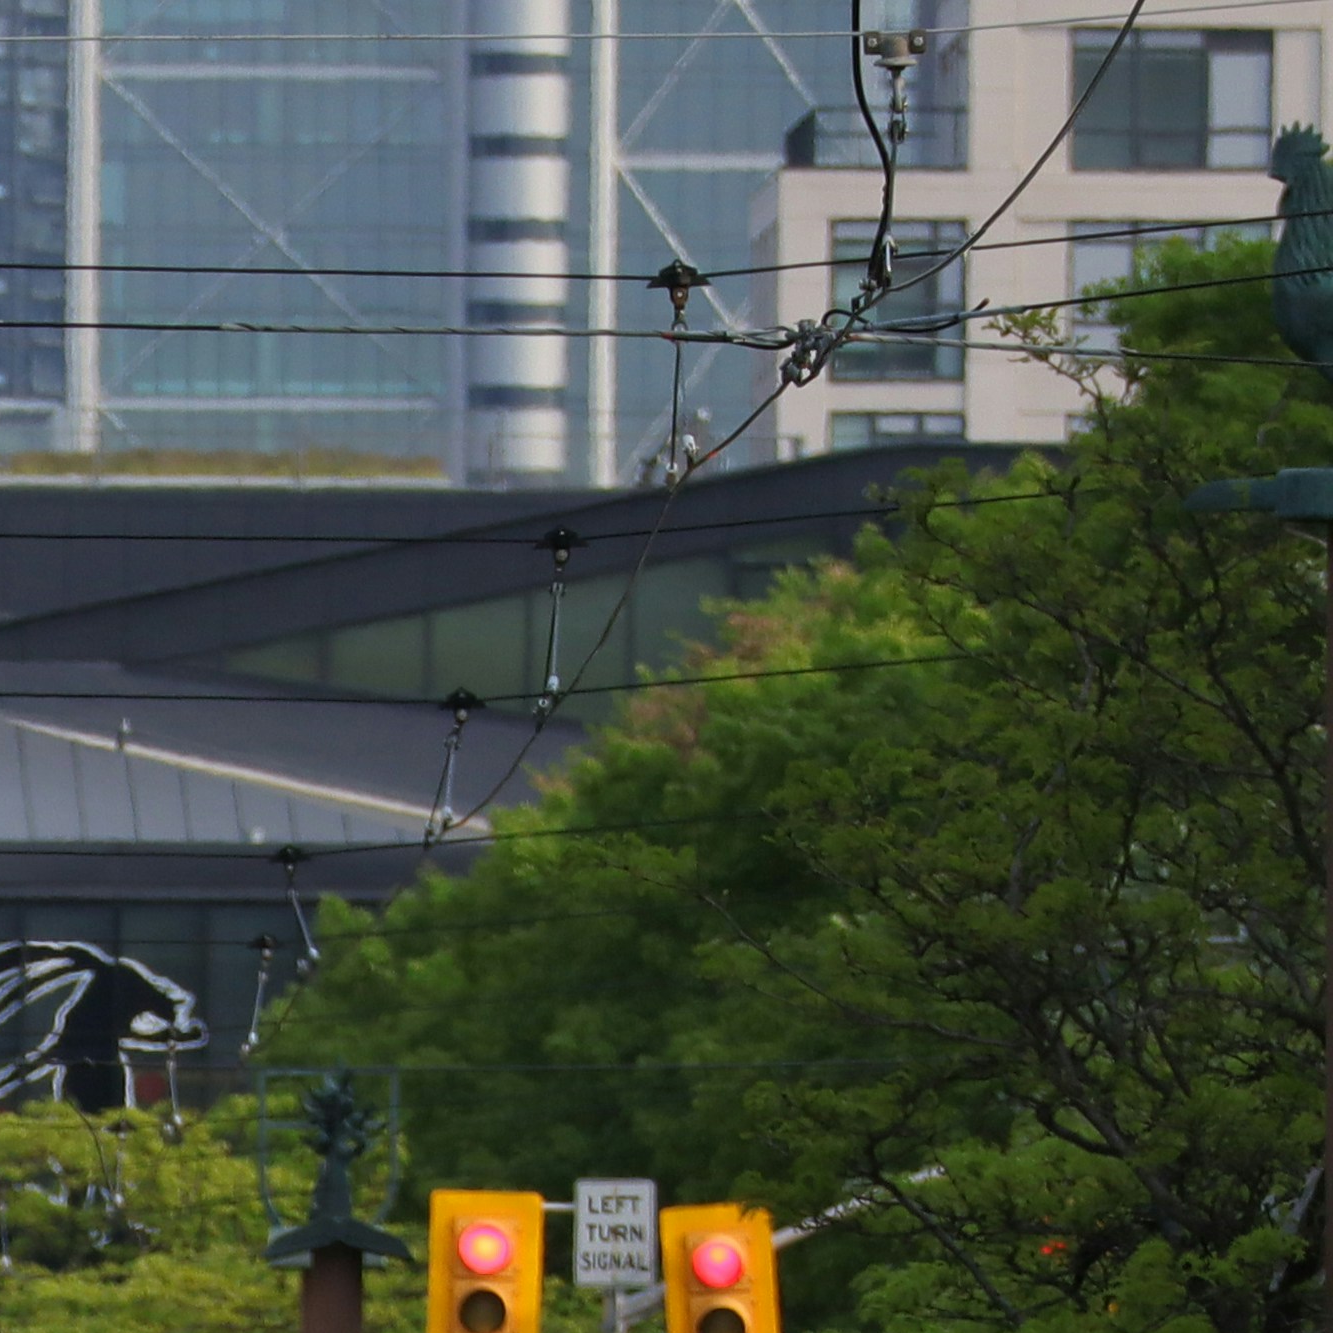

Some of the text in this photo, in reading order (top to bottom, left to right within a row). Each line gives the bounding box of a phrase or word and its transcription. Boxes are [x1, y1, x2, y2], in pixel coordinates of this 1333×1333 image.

[587, 1194, 642, 1214] LEFT
[585, 1222, 644, 1243] TURN
[579, 1251, 650, 1272] SIGNAL
